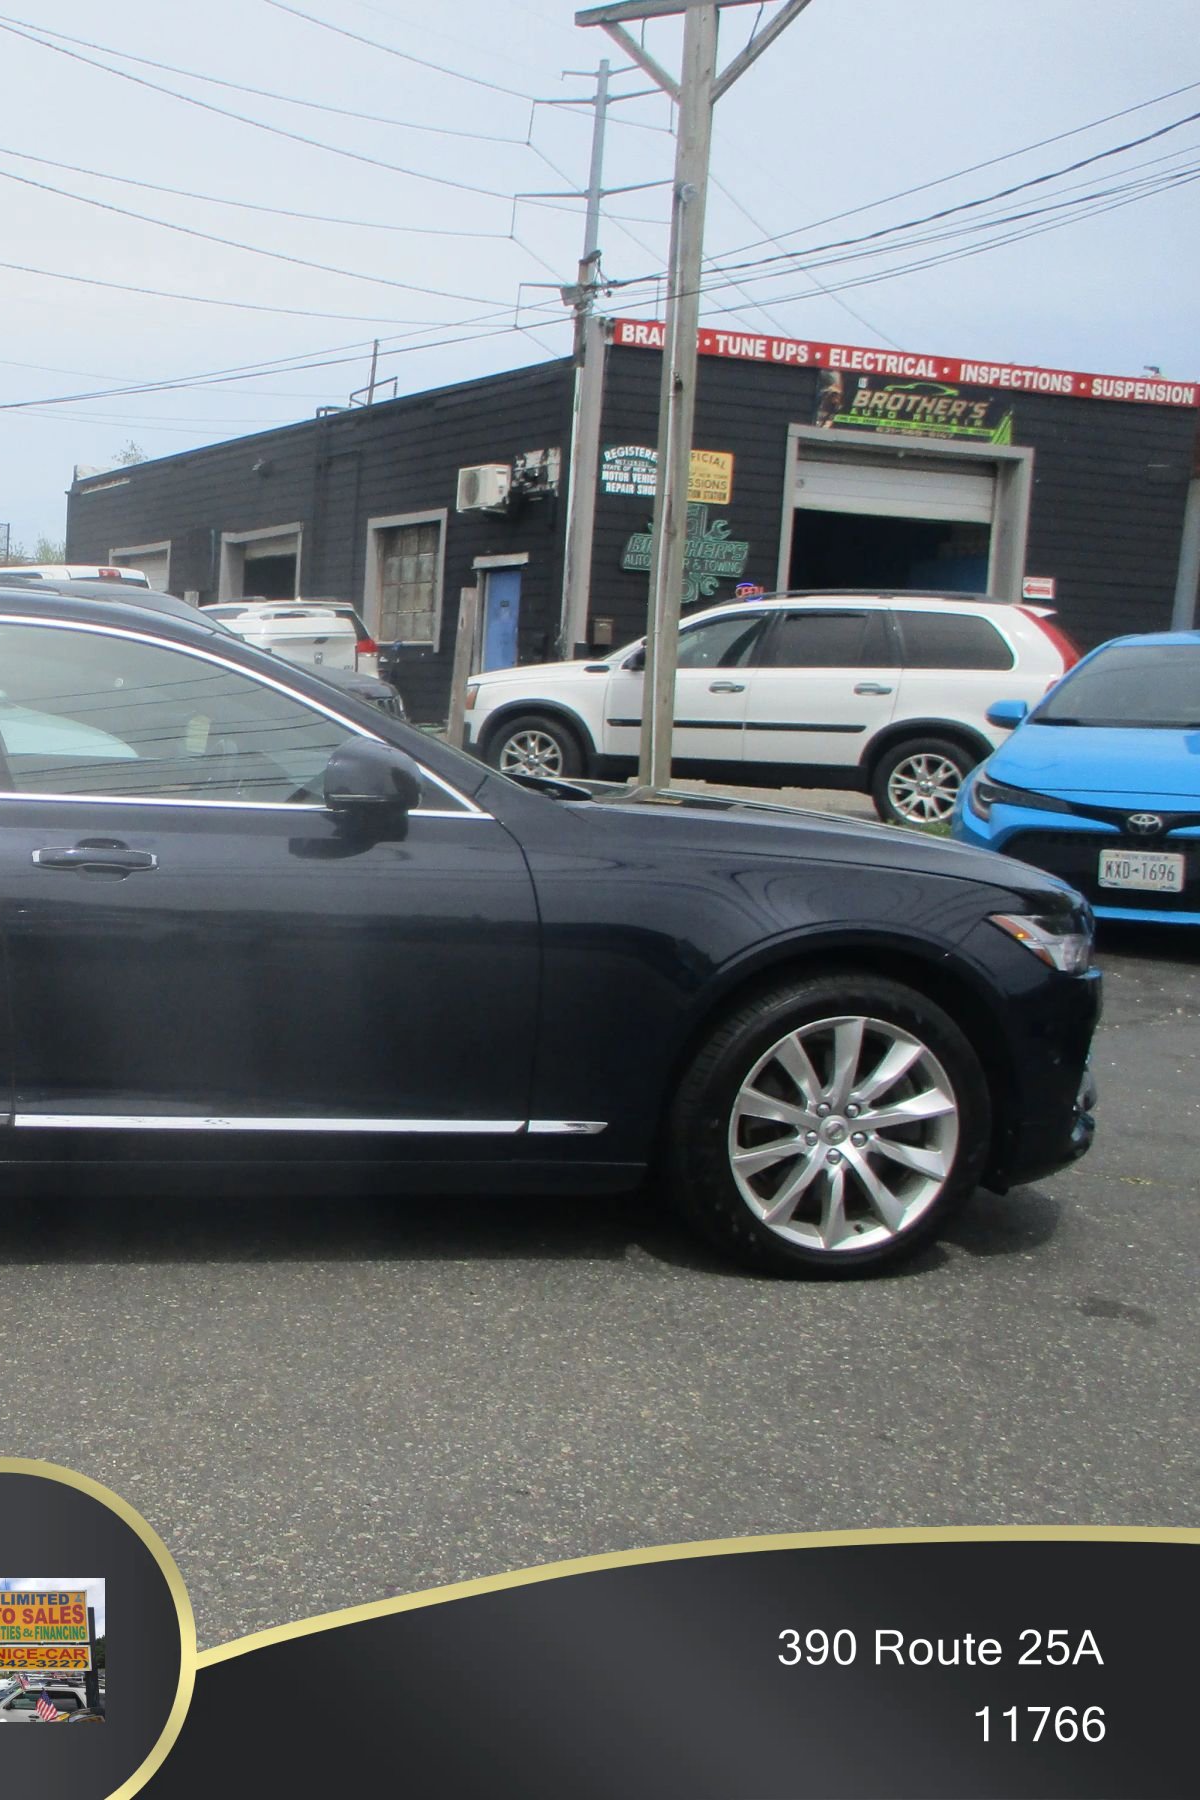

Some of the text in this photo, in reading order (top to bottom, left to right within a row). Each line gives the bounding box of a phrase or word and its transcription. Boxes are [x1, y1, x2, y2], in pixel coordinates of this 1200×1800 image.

[716, 335, 767, 358] TUNE
[772, 341, 808, 363] UPS
[829, 348, 938, 378] ELECTRICAL
[960, 363, 1073, 393] INSPECTIONS
[1092, 378, 1195, 404] SUSPENSION
[852, 390, 989, 418] BROTHER'S
[850, 408, 898, 419] AUTO
[912, 414, 984, 426] REPAIR
[604, 446, 659, 462] REGISTERE
[690, 452, 726, 469] FICIAL
[602, 471, 657, 484] MOTOR VEHIC
[688, 478, 727, 490] SSIONS
[605, 482, 635, 494] REPAIR
[629, 535, 745, 560] BRHER'S
[703, 559, 741, 574] TOWING
